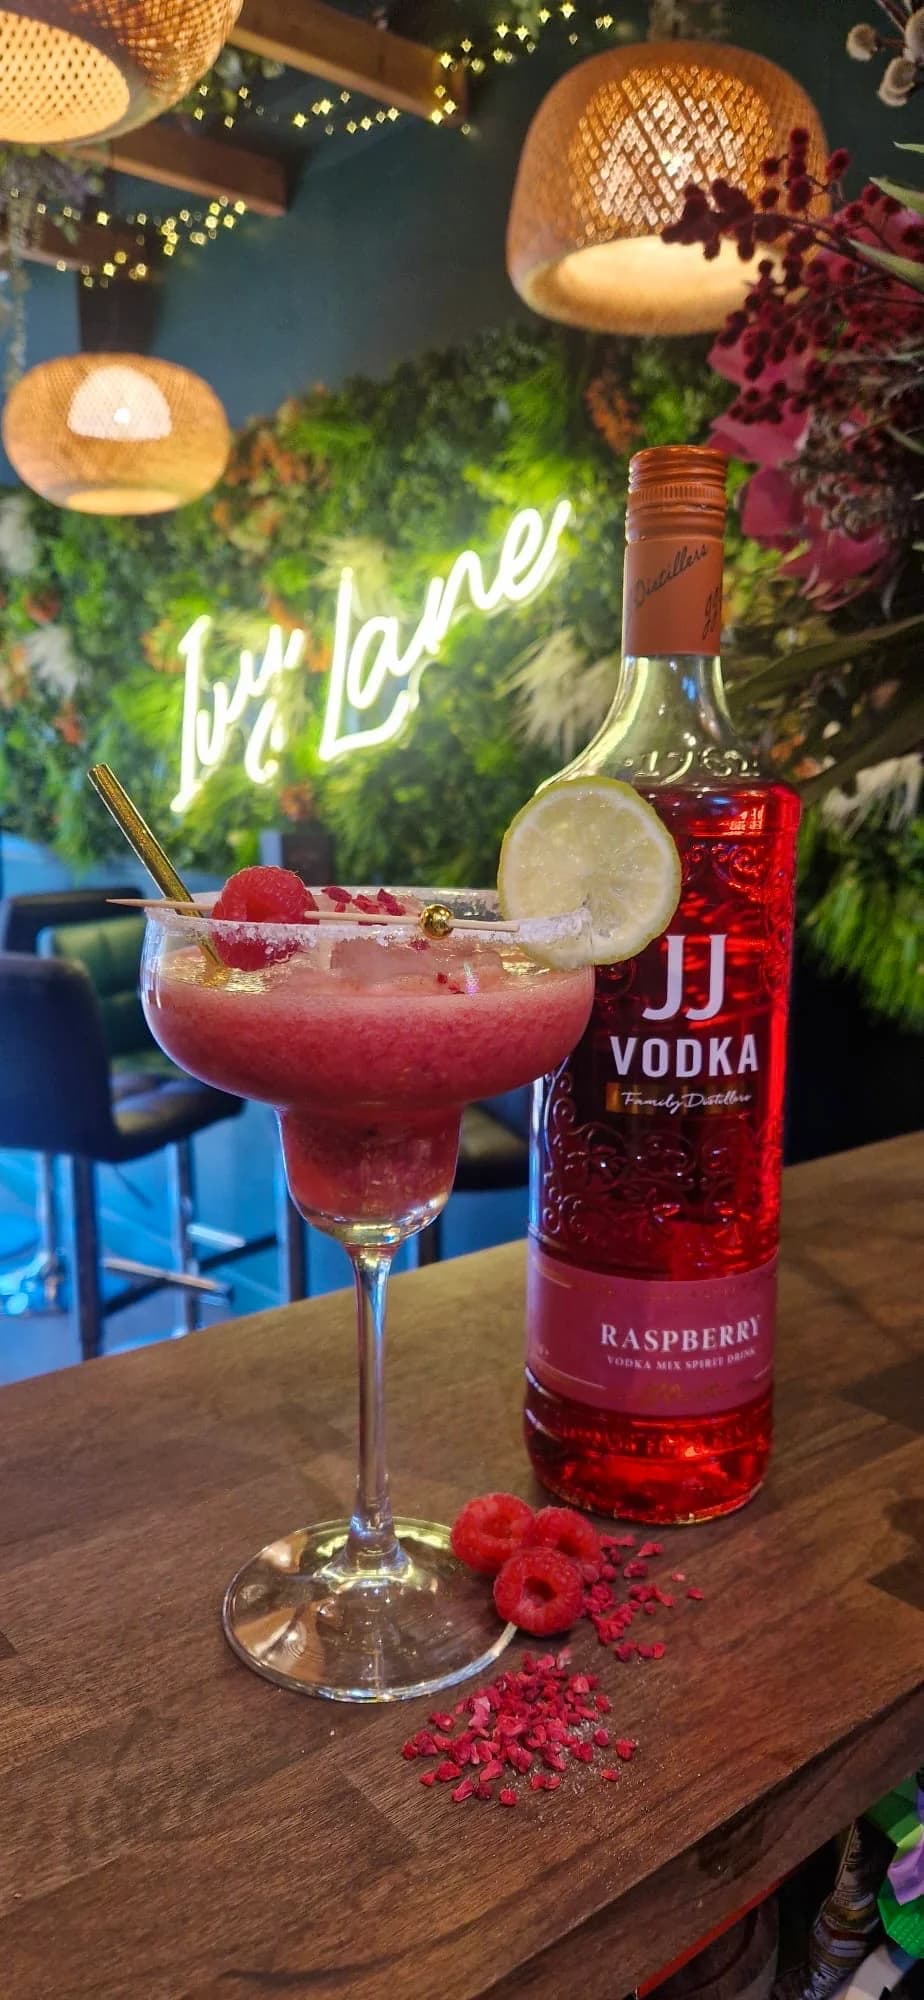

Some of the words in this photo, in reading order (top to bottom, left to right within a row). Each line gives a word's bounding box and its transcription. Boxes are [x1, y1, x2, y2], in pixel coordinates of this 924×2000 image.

[170, 614, 303, 814] Ivy
[318, 499, 572, 763] Lane
[641, 933, 728, 1021] JJ
[609, 1033, 759, 1078] VODKA
[621, 1091, 684, 1115] Family
[681, 1089, 752, 1109] Distillers
[600, 1316, 759, 1353] RASPBERRY
[606, 1355, 651, 1370] VODKA
[656, 1360, 682, 1371] MIX
[685, 1355, 725, 1370] SPIRIT
[727, 1347, 756, 1365] DRINK
